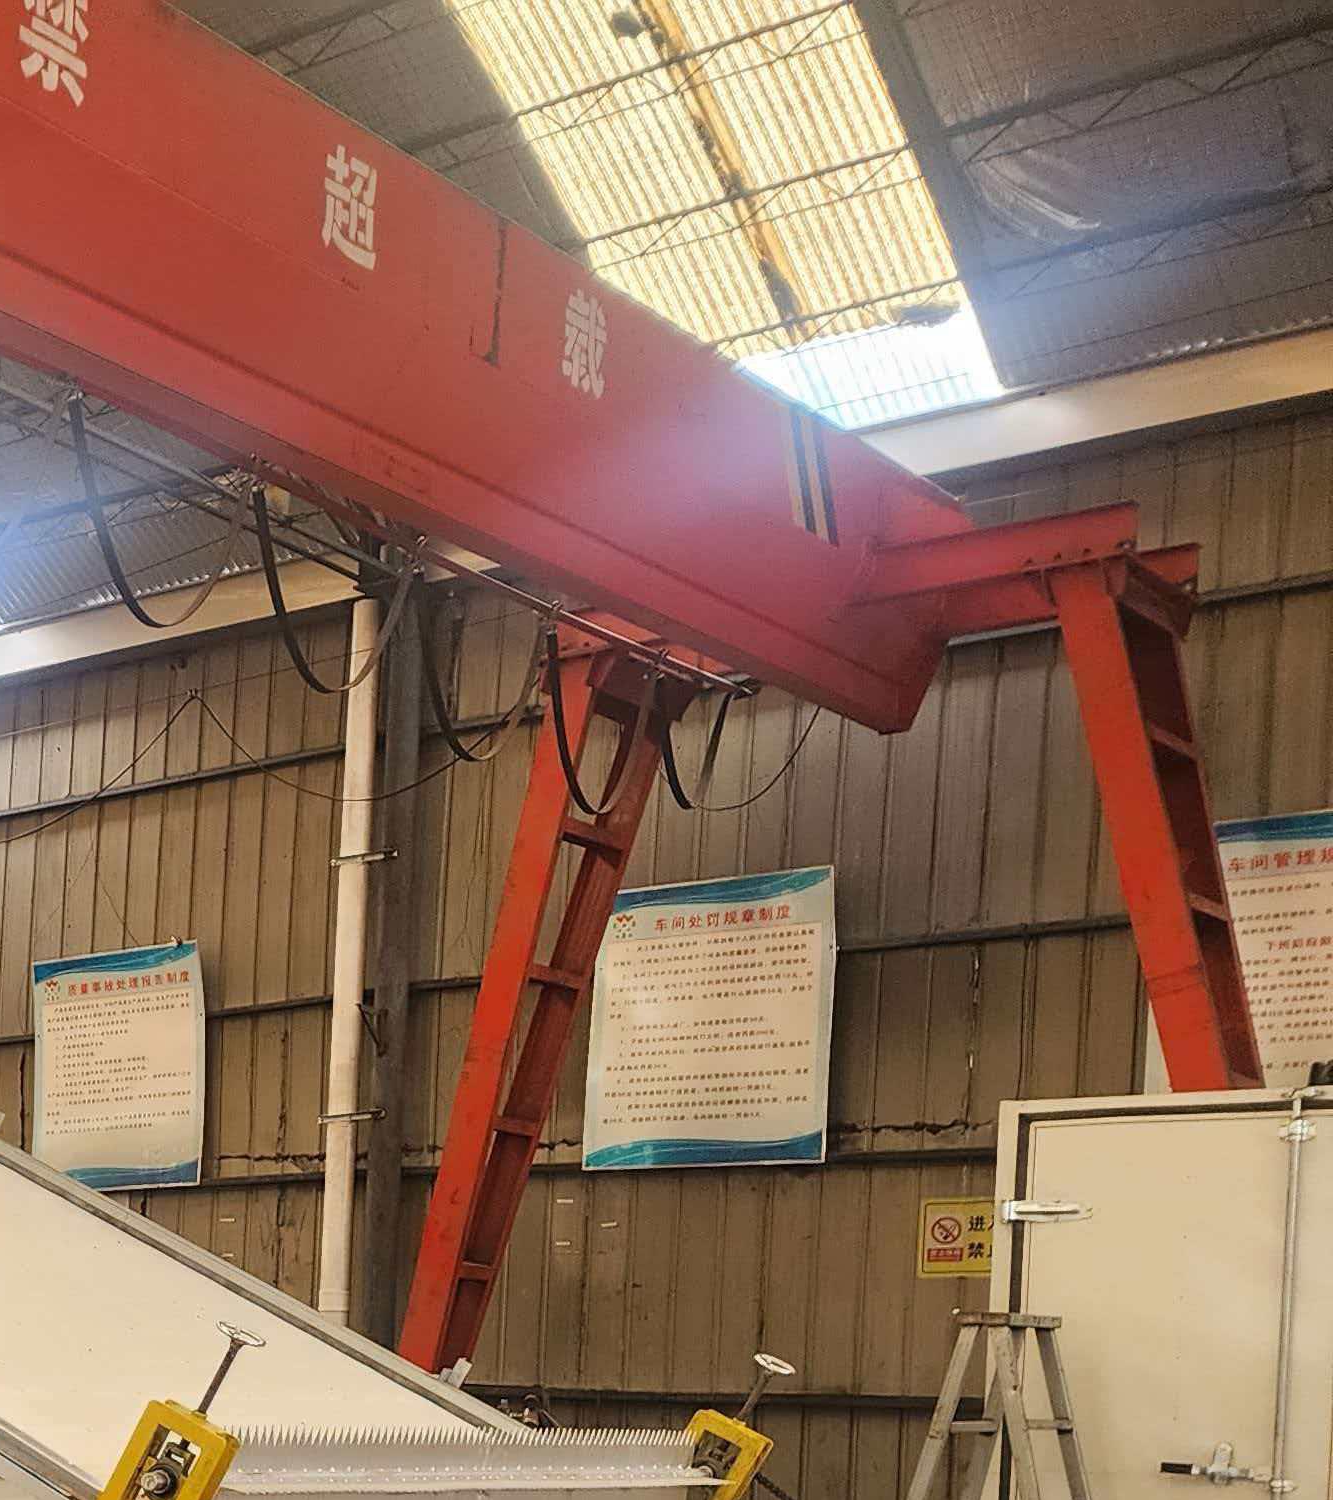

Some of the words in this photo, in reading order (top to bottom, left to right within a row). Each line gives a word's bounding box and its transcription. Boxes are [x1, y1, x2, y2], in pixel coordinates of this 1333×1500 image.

[654, 904, 791, 933] 车间处罚规章制度
